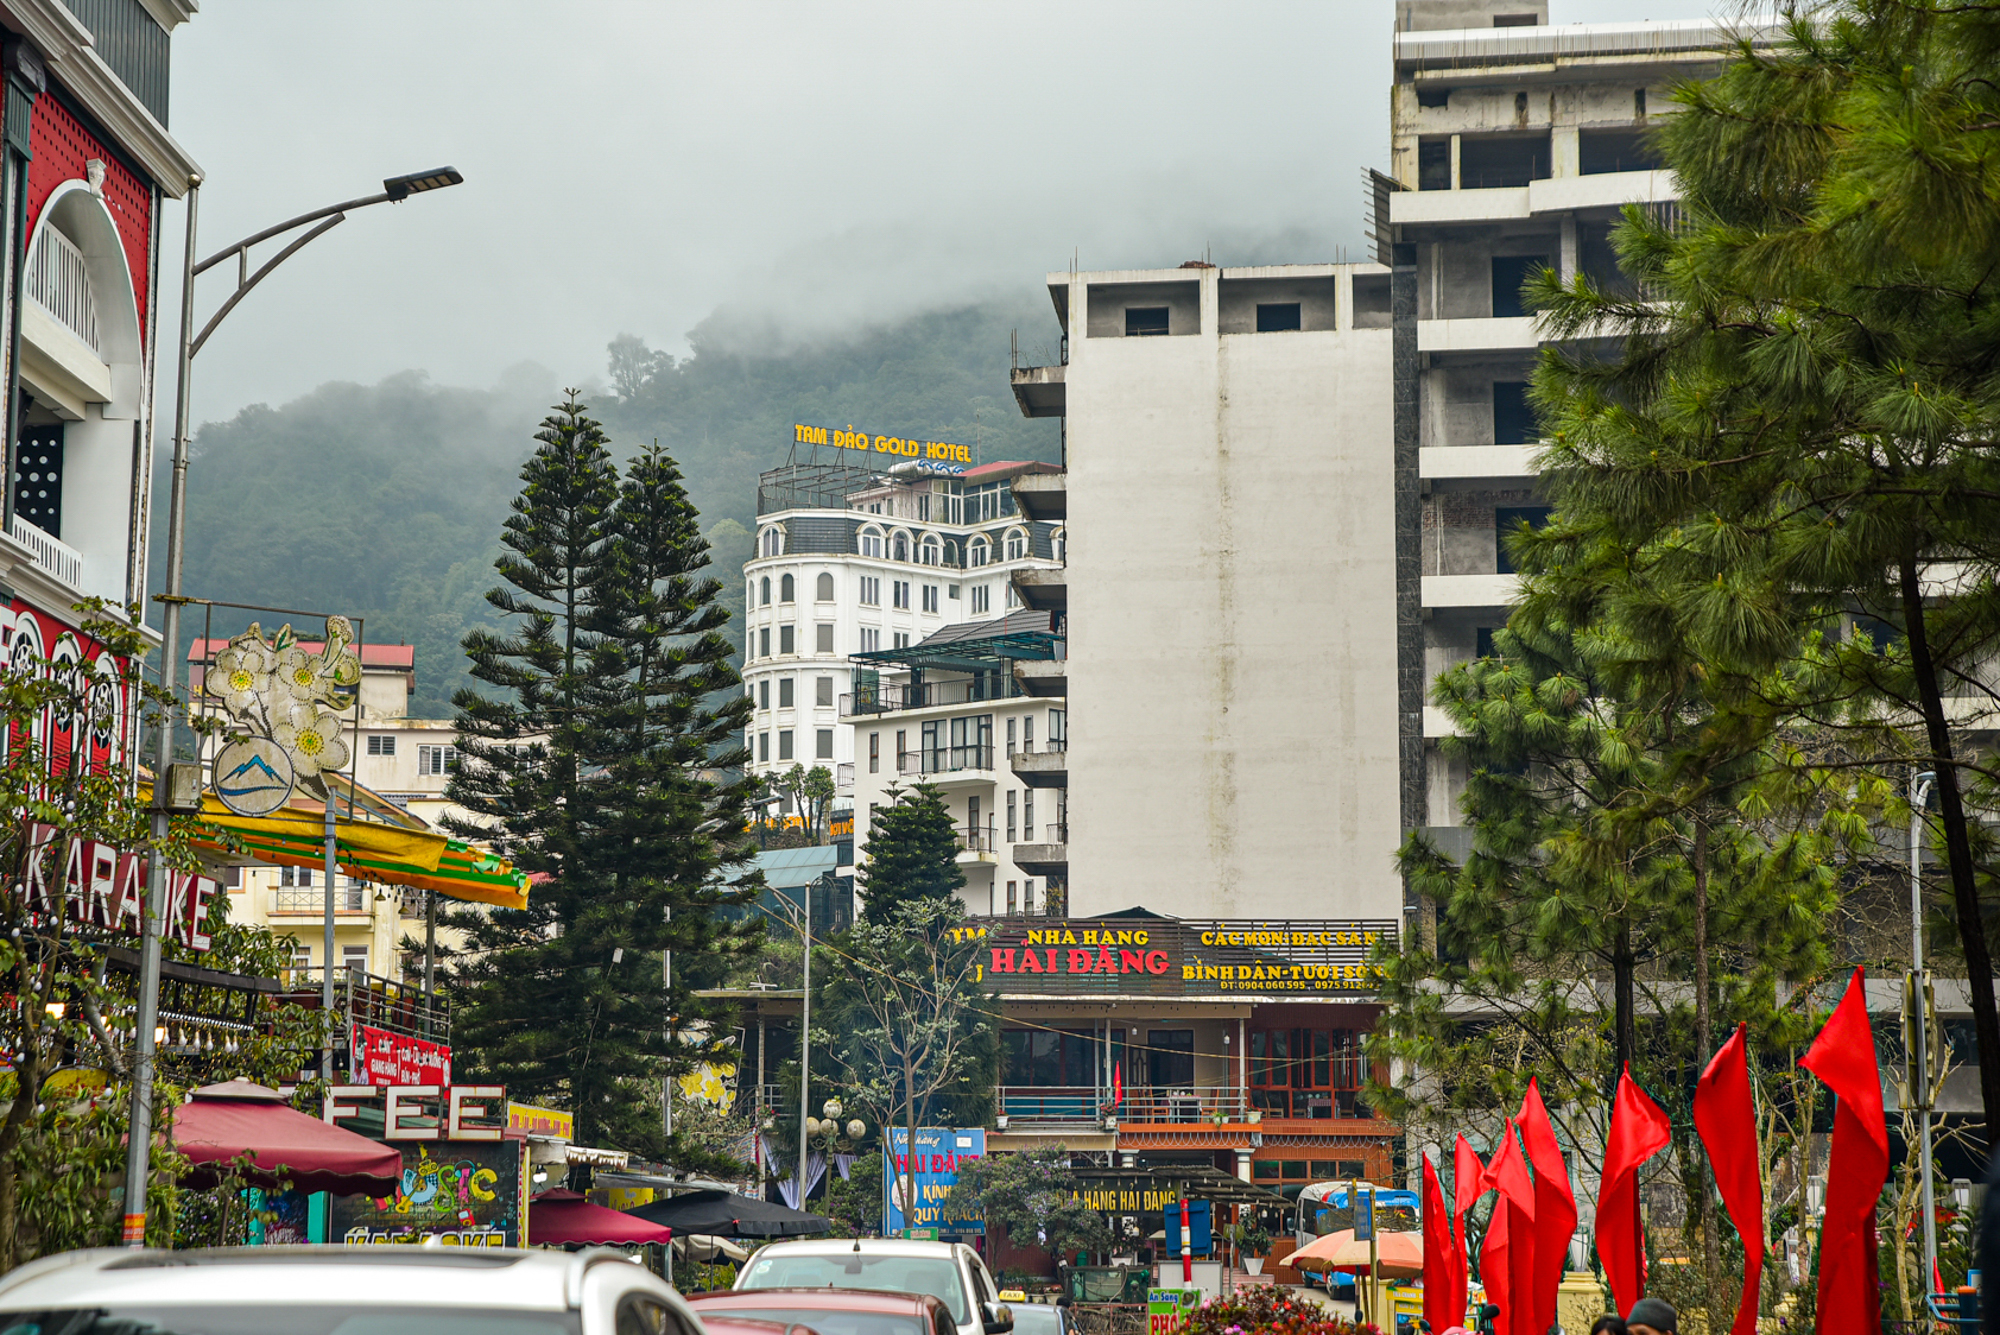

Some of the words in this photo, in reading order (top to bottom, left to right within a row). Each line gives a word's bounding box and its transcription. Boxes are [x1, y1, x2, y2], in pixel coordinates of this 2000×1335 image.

[795, 424, 827, 445] TAM
[833, 424, 869, 450] ĐẢO
[874, 435, 919, 457] GOLD
[926, 441, 972, 463] HOTEL
[20, 821, 217, 951] KARAKE
[1027, 922, 1077, 945] NHÀ
[1083, 922, 1150, 945] HÀNG
[1201, 923, 1240, 946] CÁC
[990, 939, 1058, 973] HẢI
[1067, 943, 1170, 974] ĐĂNG
[1182, 955, 1234, 980] BÌNH
[1343, 955, 1392, 980] SỐN
[923, 1180, 953, 1204] KÍNH
[1083, 1185, 1116, 1211] HÀNG
[1120, 1182, 1140, 1211] HẢI
[1143, 1184, 1176, 1211] ĐĂNG
[913, 1203, 941, 1226] QUÝ
